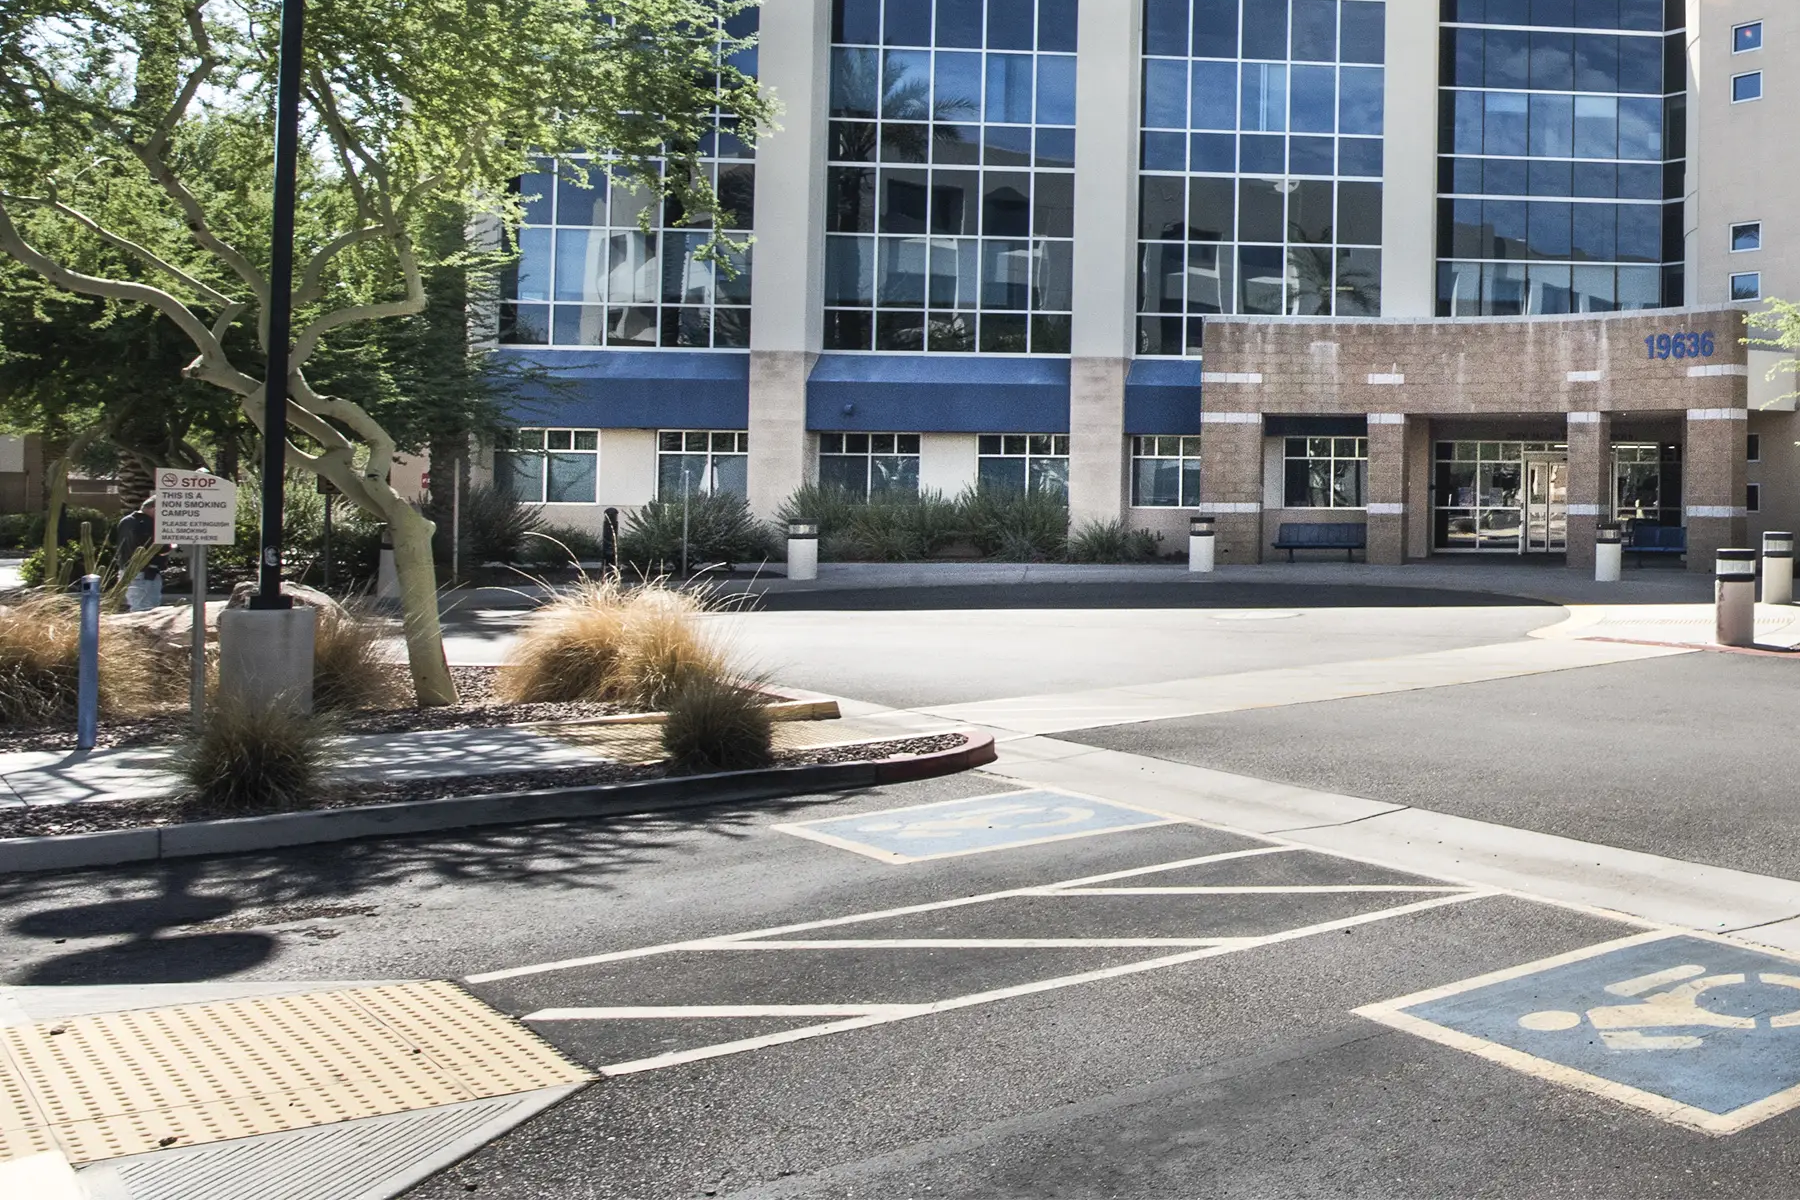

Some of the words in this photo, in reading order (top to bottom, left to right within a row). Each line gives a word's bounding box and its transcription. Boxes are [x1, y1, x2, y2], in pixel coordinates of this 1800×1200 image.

[1644, 330, 1715, 360] 19636
[181, 477, 217, 488] STOP
[161, 509, 200, 517] CAMPUS
